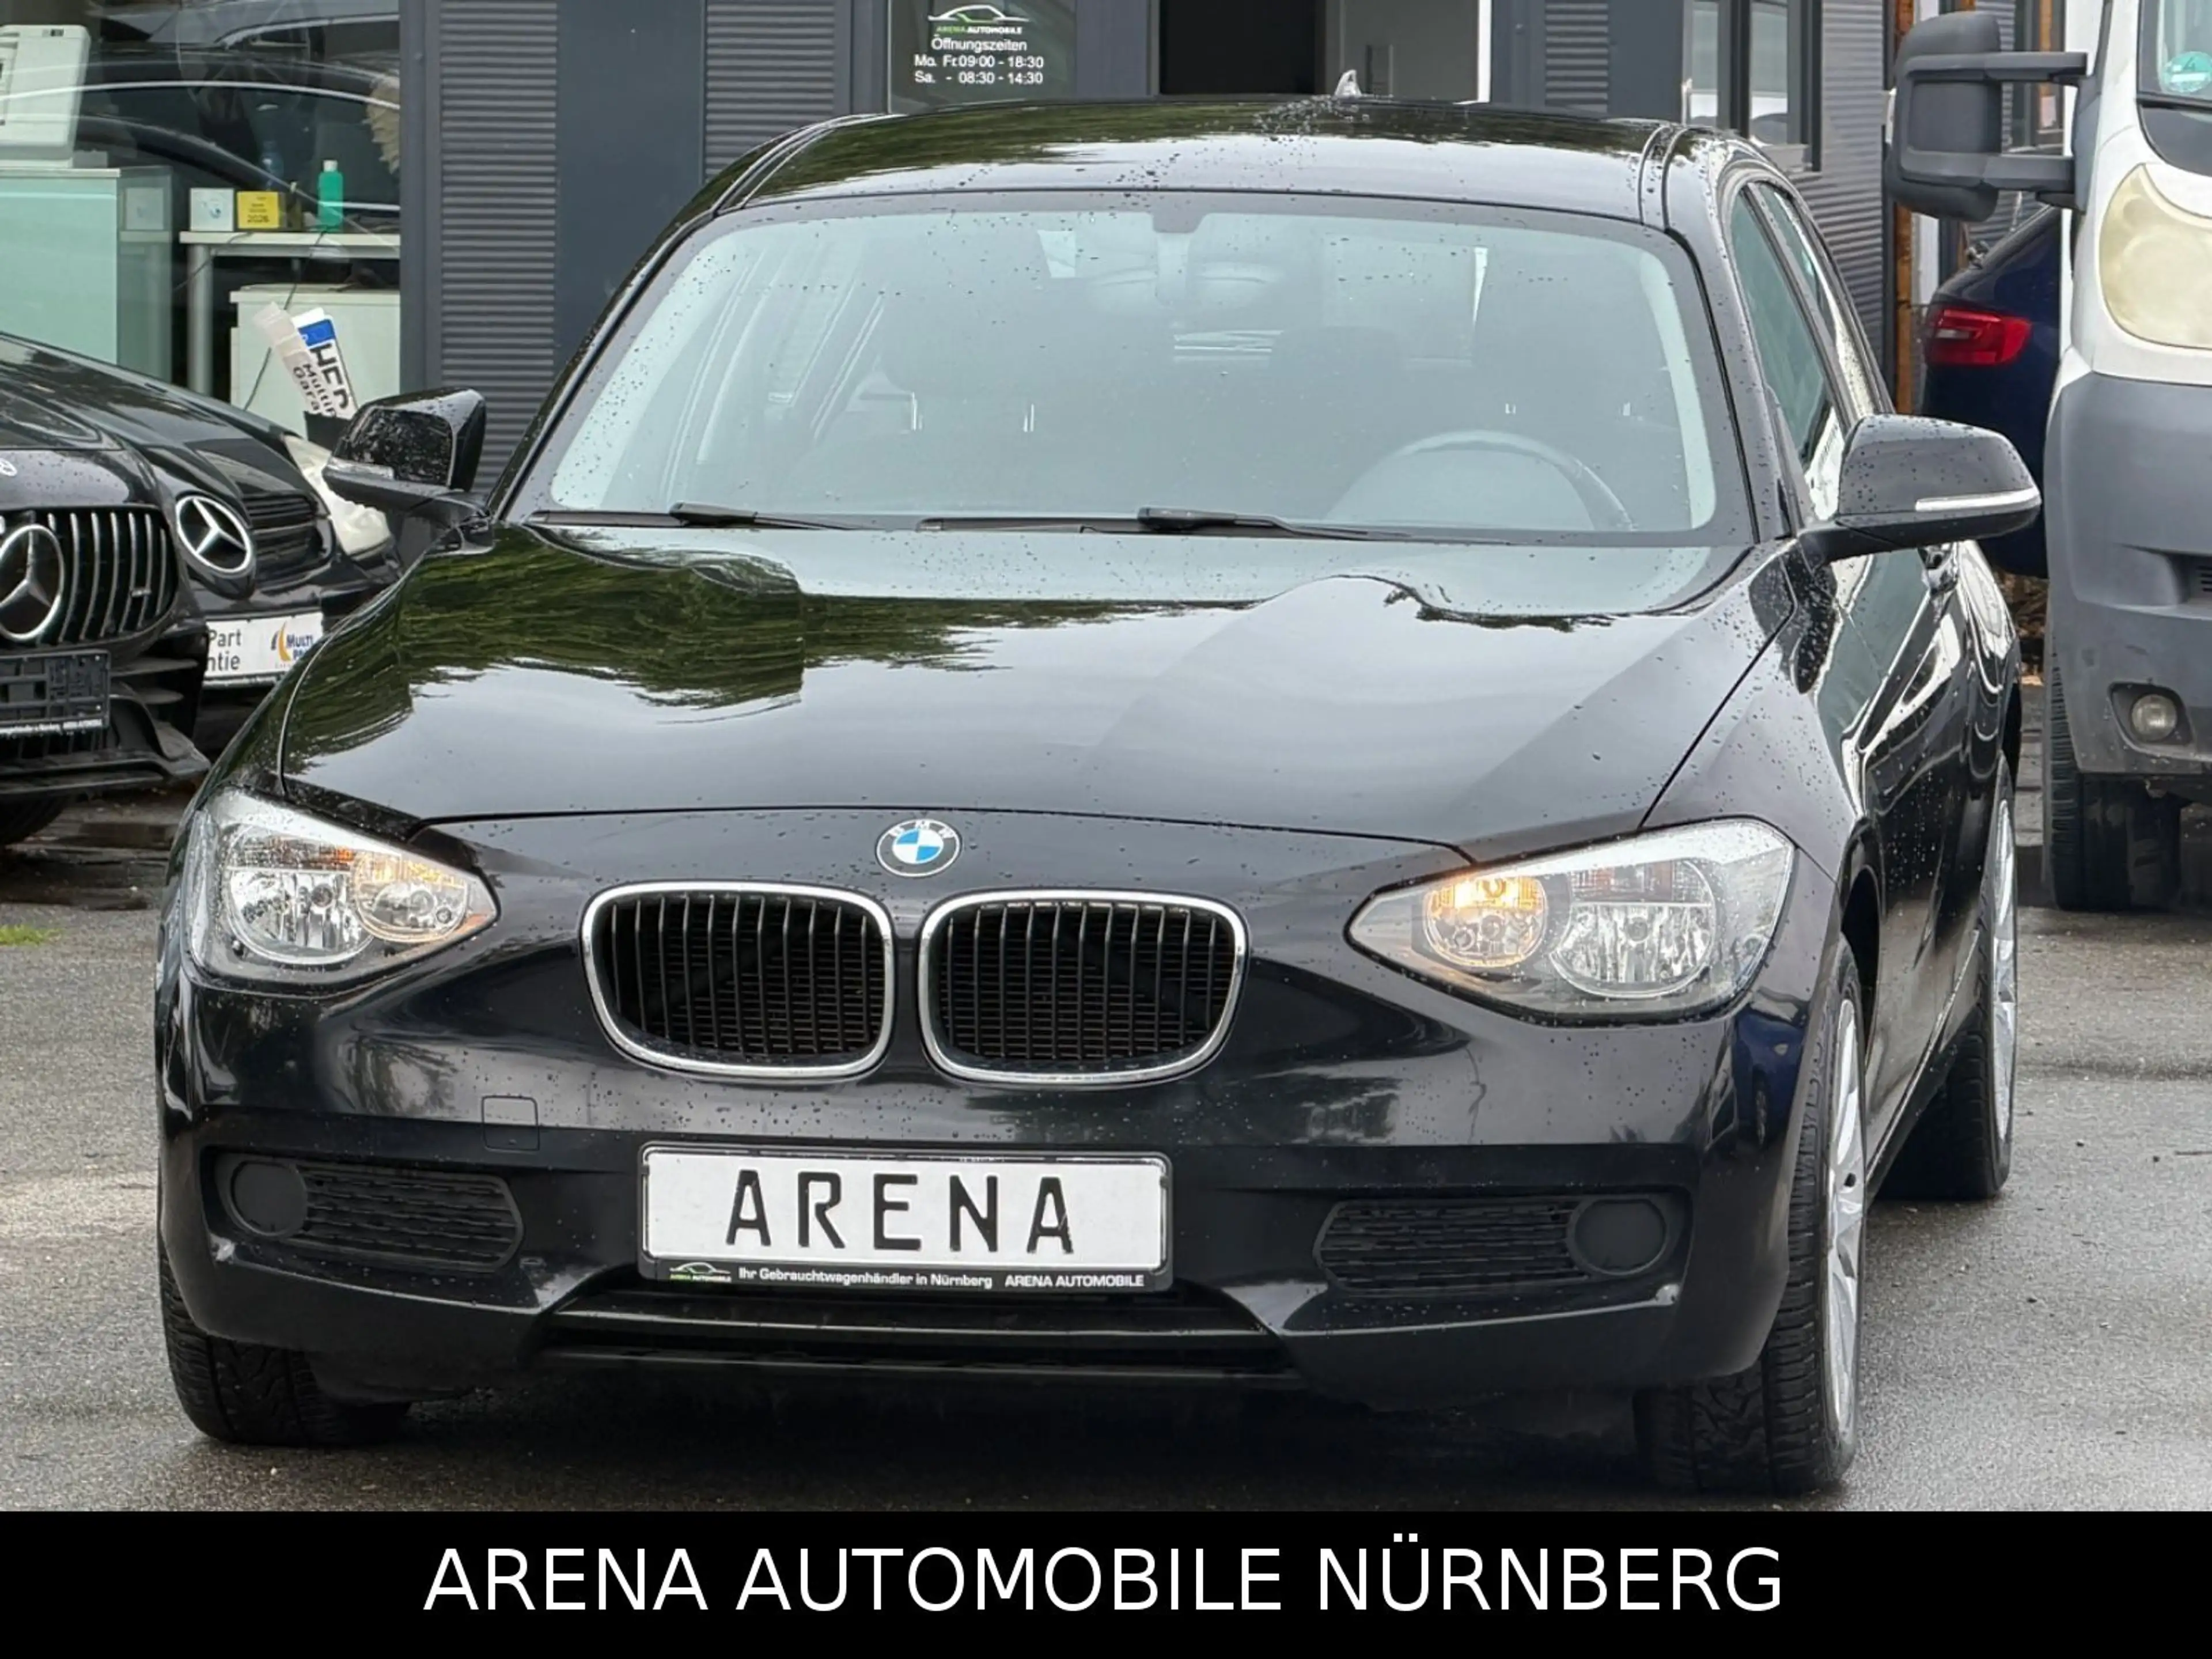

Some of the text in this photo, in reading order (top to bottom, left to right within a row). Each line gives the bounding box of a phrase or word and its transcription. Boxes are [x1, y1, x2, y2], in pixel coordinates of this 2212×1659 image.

[967, 26, 1022, 35] AUTOMOBILE
[931, 34, 1028, 53] Öffnungszeiten
[1008, 56, 1044, 68] 18:30
[914, 70, 936, 84] Sa.
[958, 71, 995, 84] 08:30
[1007, 72, 1043, 84] 14:30
[728, 1171, 1071, 1252] ARENA
[738, 1267, 756, 1279] Ihr
[759, 1267, 913, 1286] Gebrauchtwagenhändler
[916, 1273, 927, 1285] in
[930, 1273, 993, 1290] Nürnberg
[1005, 1274, 1053, 1287] ARENA
[1055, 1275, 1145, 1287] AUTOMOBILE
